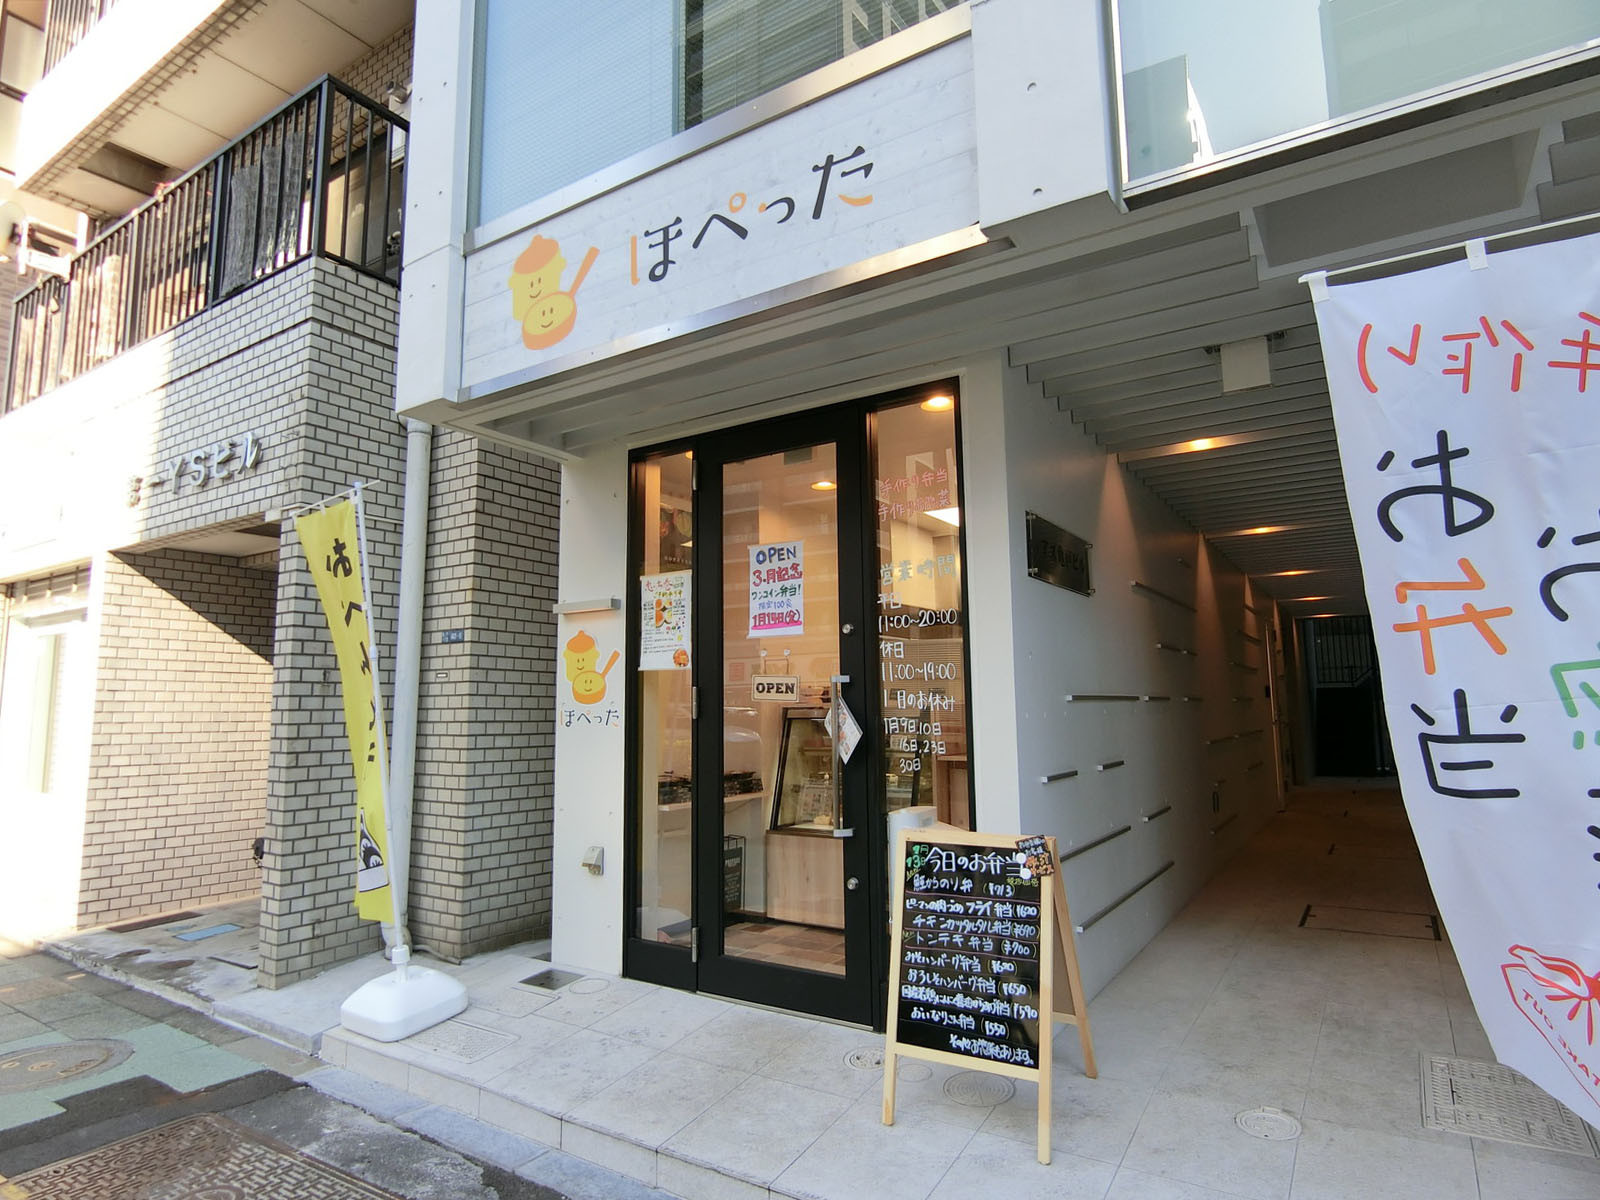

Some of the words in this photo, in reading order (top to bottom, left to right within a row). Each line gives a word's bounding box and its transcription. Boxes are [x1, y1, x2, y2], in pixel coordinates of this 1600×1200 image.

[630, 145, 874, 286] ほぺった
[755, 546, 797, 565] OPEN
[880, 554, 957, 586] 営業時間
[877, 592, 903, 610] 平日
[880, 640, 904, 659] 休日
[756, 682, 796, 695] OPEN
[560, 709, 620, 728] ほぺった
[899, 758, 921, 773] 30日
